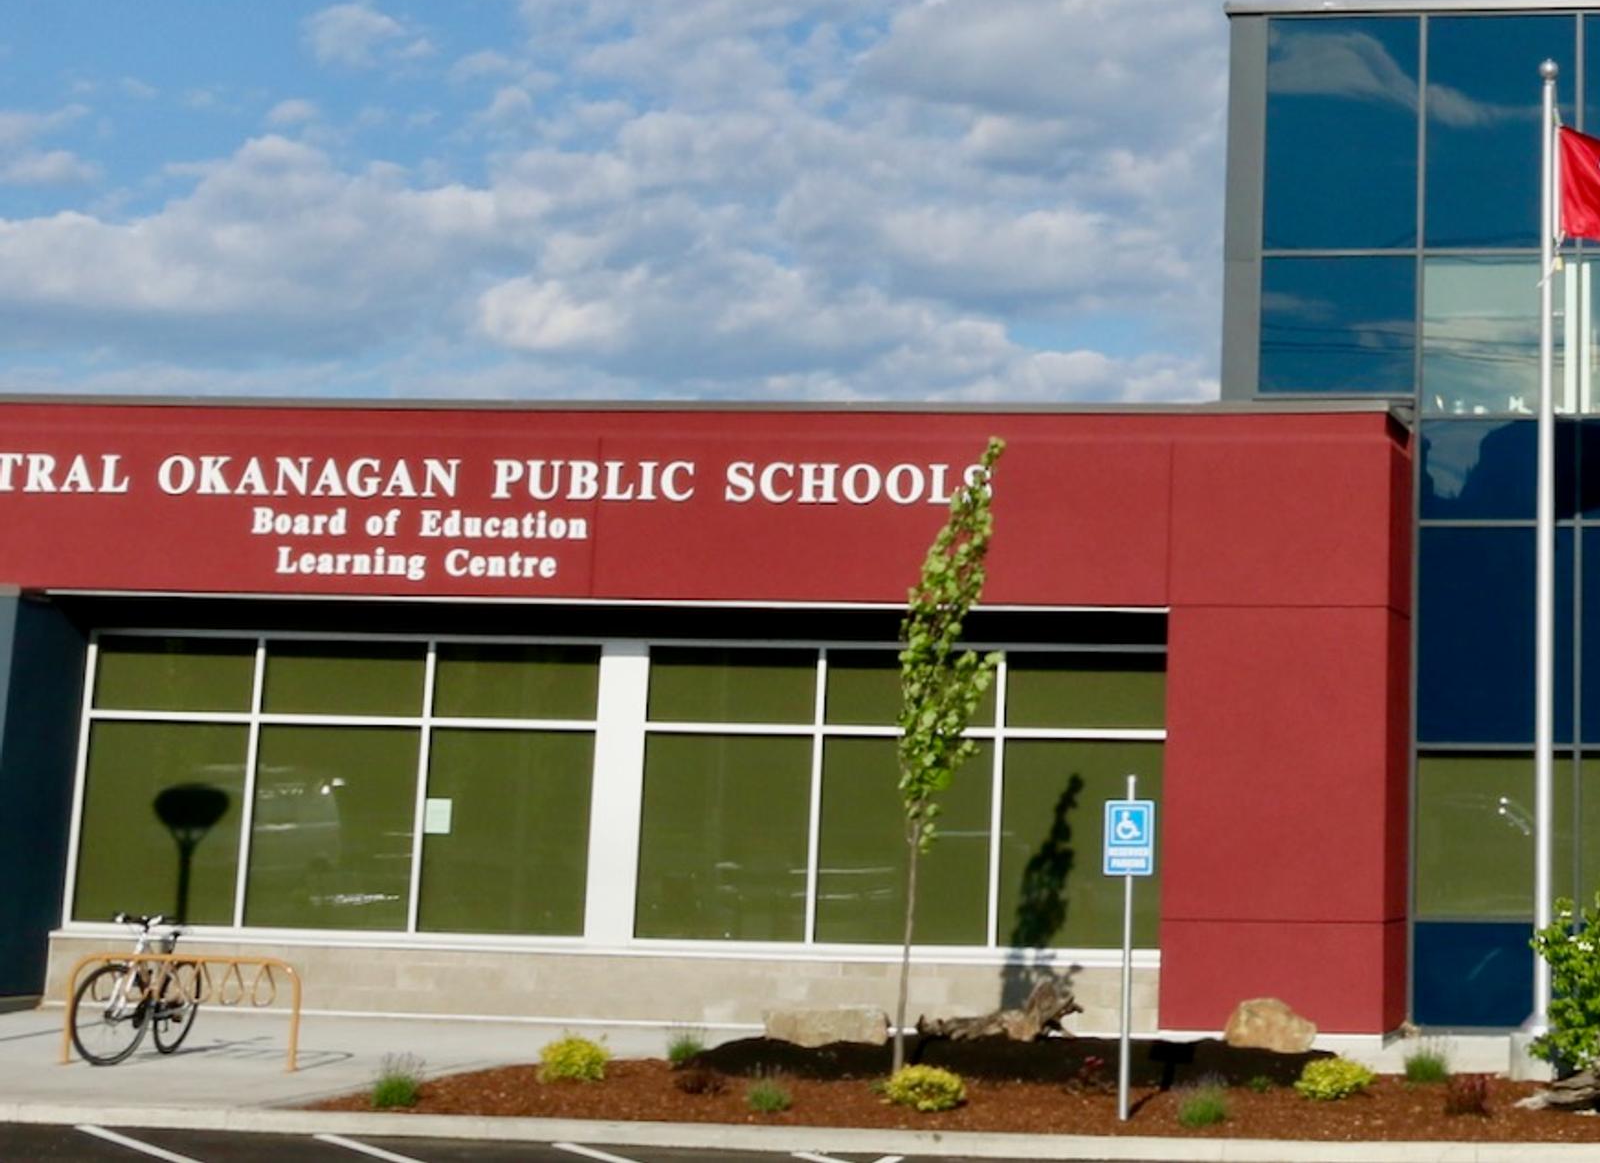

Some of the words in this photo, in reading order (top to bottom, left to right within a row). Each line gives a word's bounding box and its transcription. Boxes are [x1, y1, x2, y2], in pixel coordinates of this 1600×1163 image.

[157, 454, 462, 498] OKANAGAN
[490, 458, 695, 502] PUBLIC
[724, 461, 993, 505] SCHOOLS
[251, 506, 348, 537] Board
[365, 508, 402, 537] of
[419, 509, 588, 540] Education
[276, 546, 427, 581] Learning
[444, 548, 558, 579] Centre
